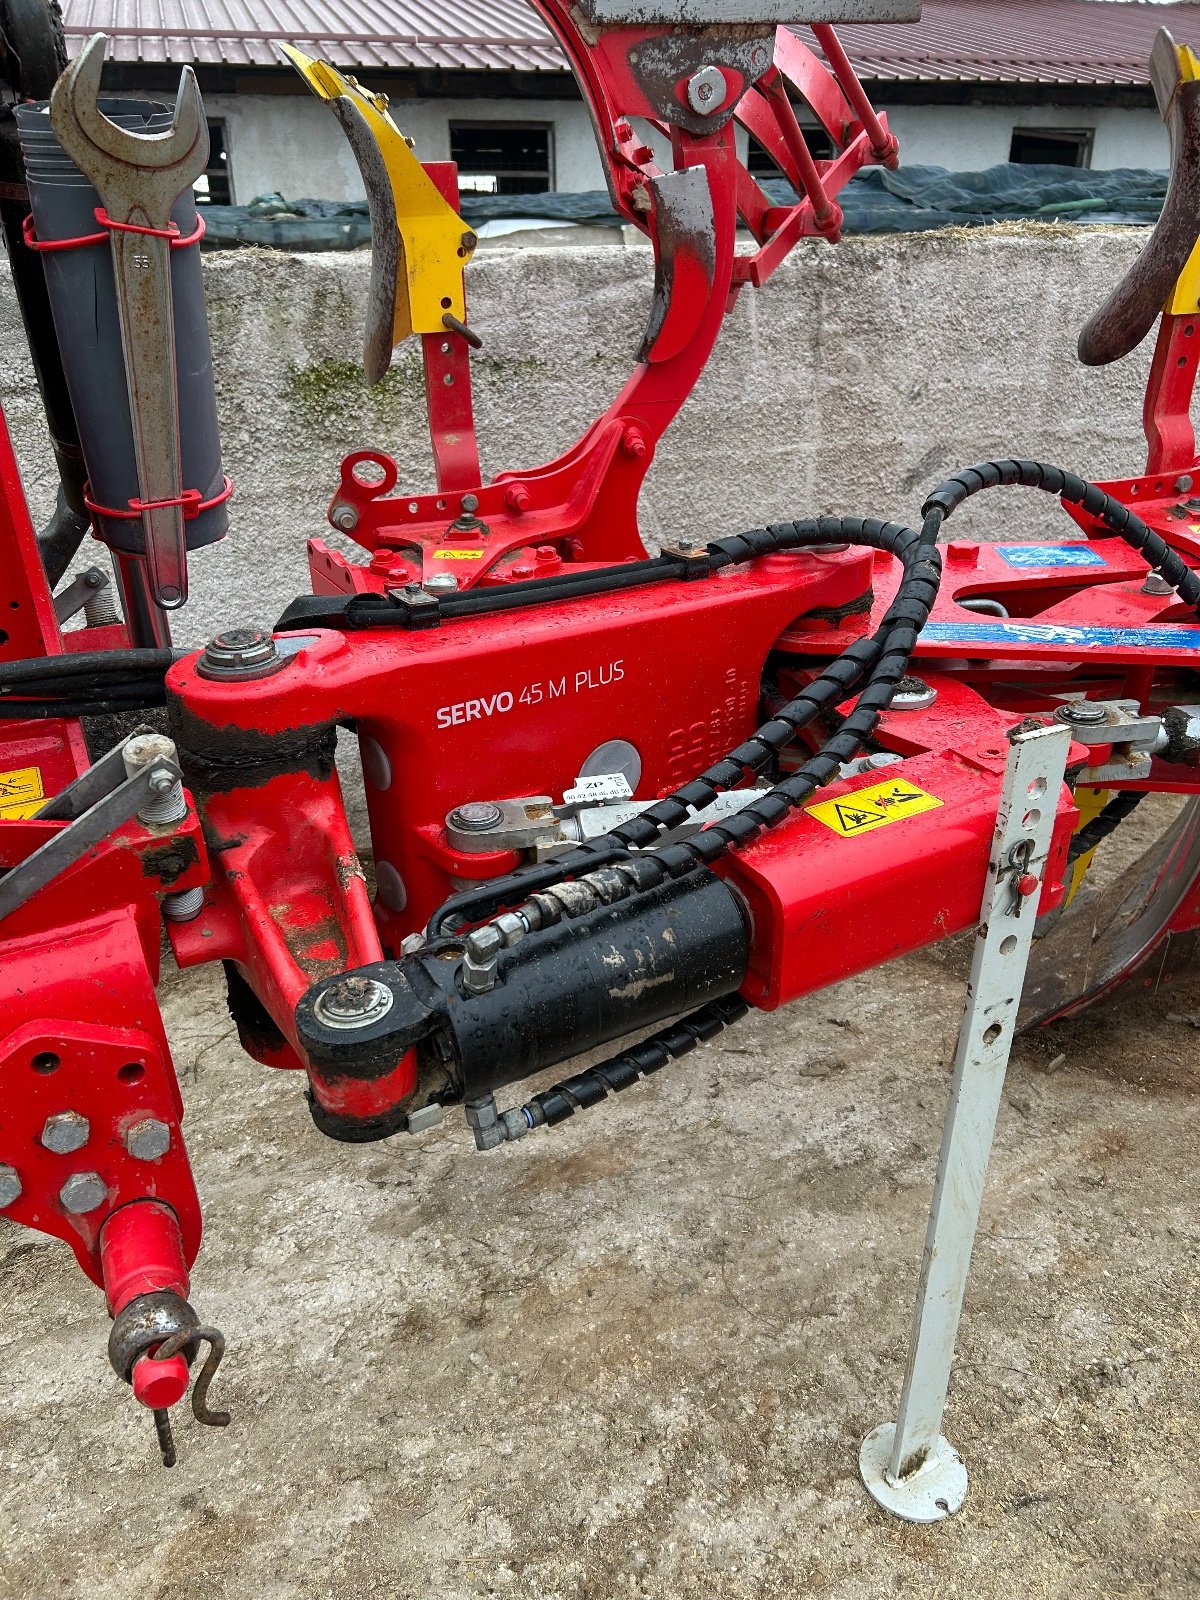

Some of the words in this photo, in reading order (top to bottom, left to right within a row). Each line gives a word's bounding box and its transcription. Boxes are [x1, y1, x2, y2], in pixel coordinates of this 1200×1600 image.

[436, 691, 514, 729] SERVO
[518, 682, 543, 705] 45
[549, 676, 566, 699] M
[575, 659, 625, 693] PLUS
